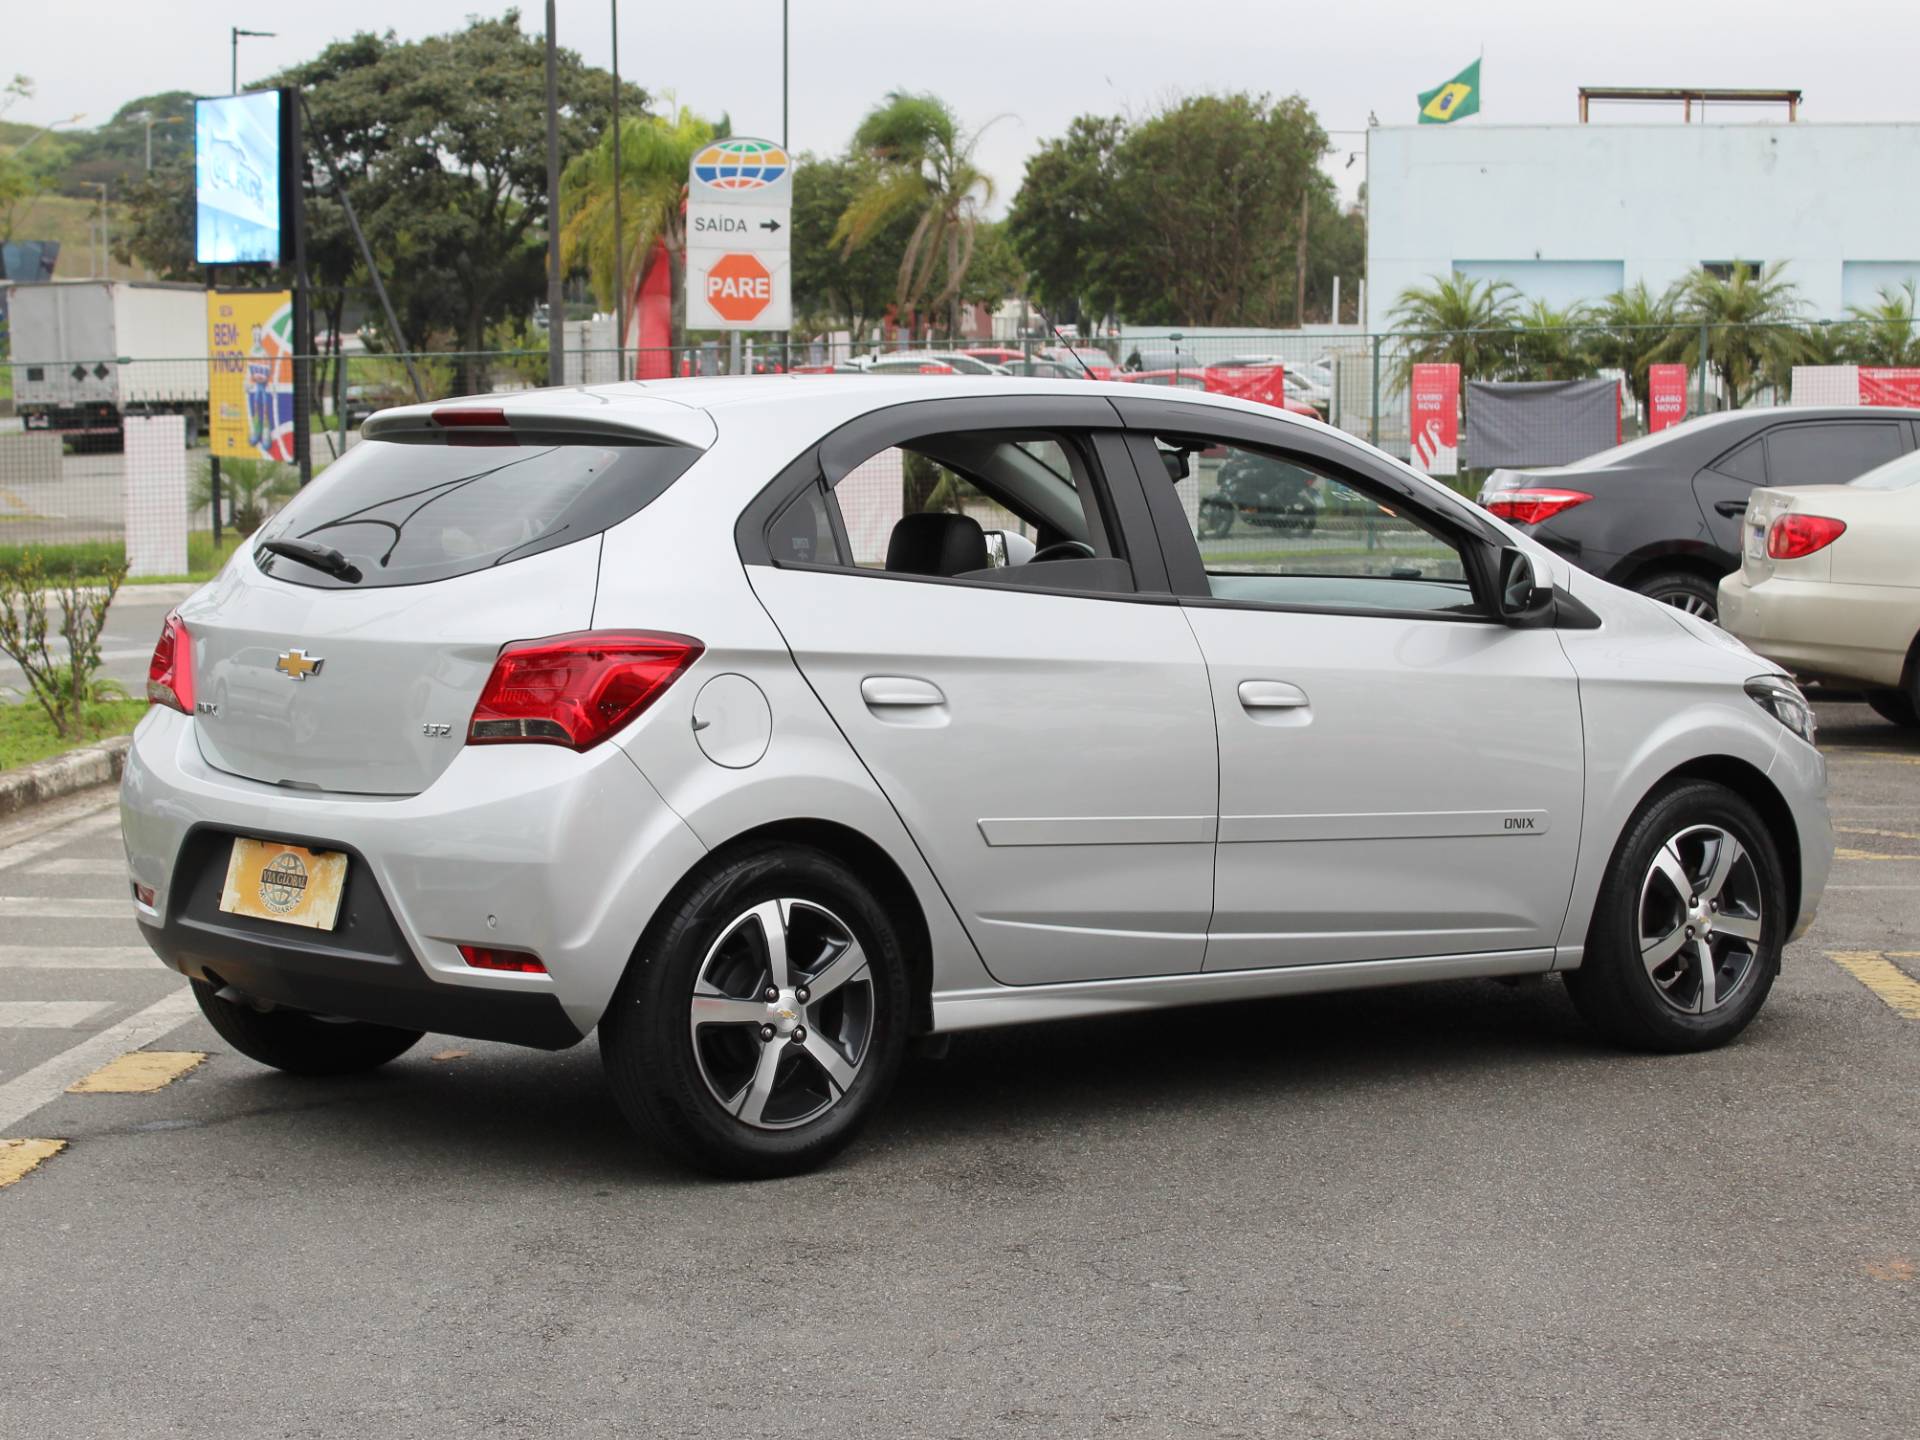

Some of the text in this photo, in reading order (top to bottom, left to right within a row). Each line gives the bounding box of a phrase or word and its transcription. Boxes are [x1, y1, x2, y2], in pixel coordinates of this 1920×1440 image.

[695, 214, 747, 233] SAÍDA
[708, 276, 769, 299] PARE
[210, 350, 244, 373] VINDO
[1504, 818, 1535, 829] ONIX
